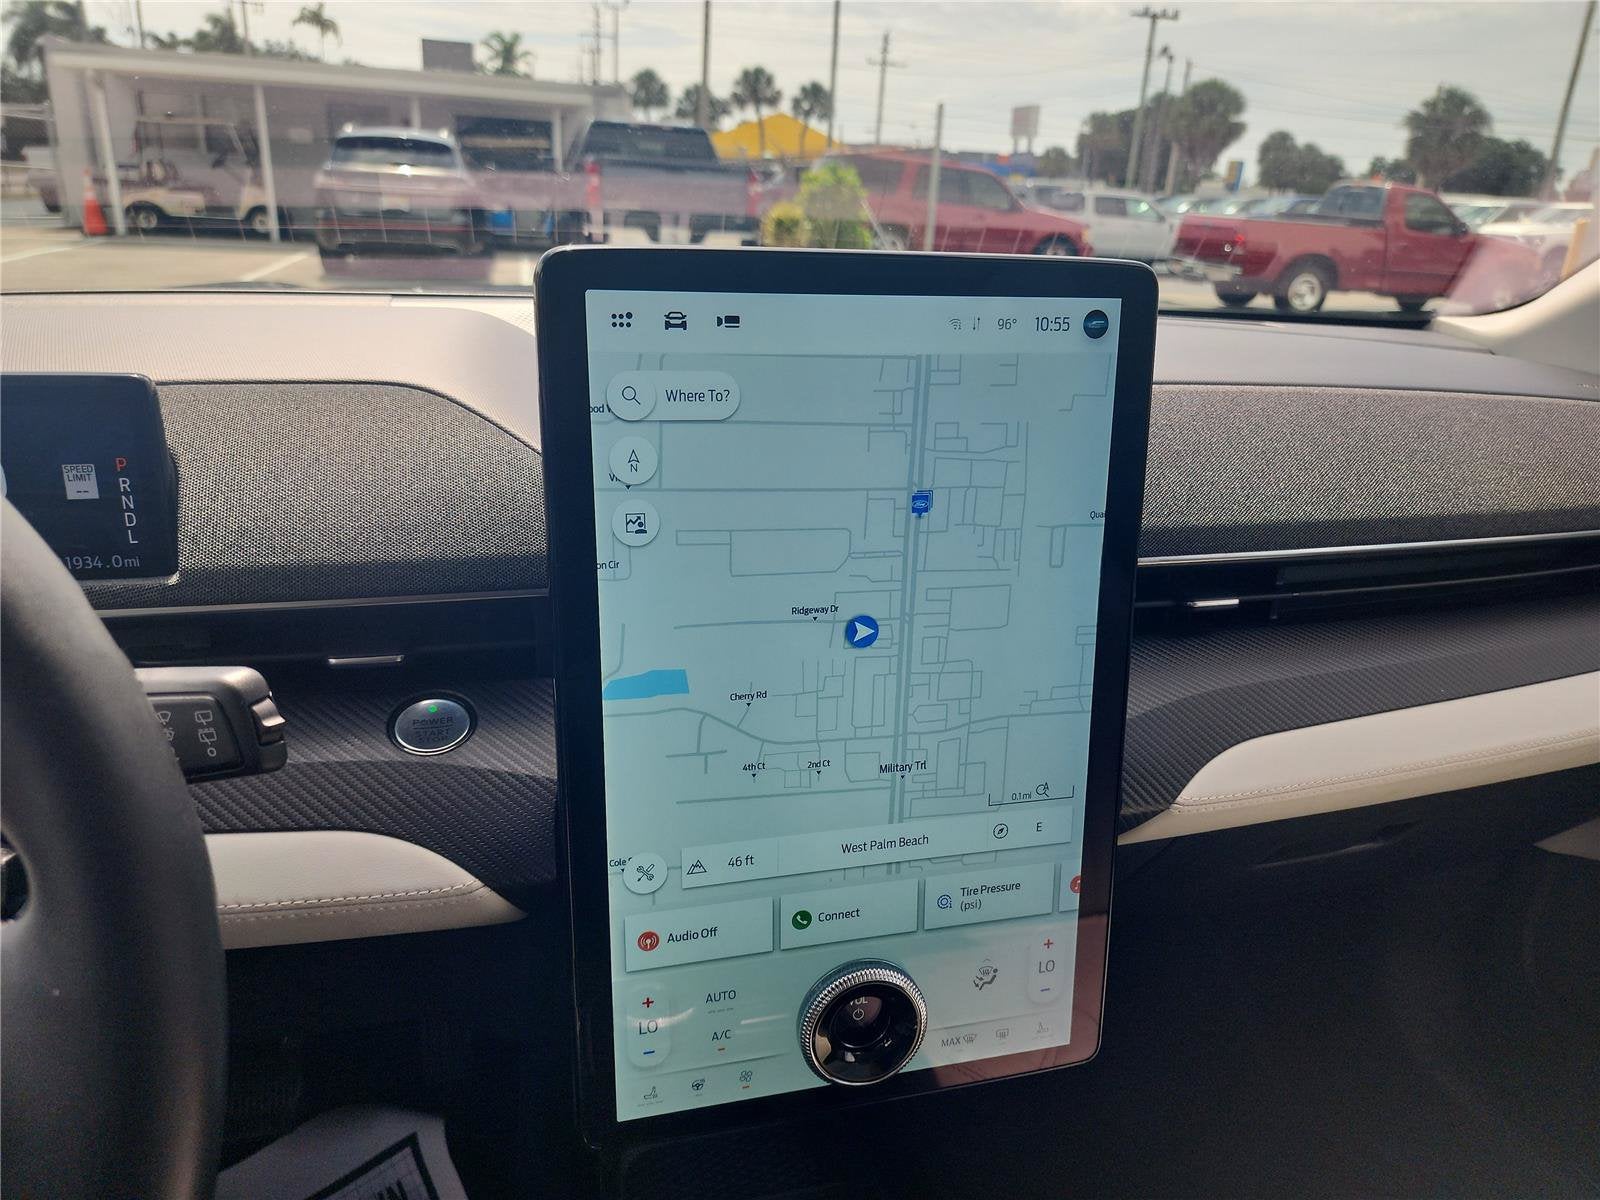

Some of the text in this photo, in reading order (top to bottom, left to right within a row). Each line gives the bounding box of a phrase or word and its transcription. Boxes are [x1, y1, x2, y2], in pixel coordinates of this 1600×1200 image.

[997, 318, 1017, 331] 96°
[1035, 316, 1070, 332] 10:55
[665, 388, 730, 402] Where To?
[63, 465, 93, 475] SPEED
[115, 457, 128, 471] P
[630, 463, 638, 473] N
[67, 473, 92, 482] LIMIT
[118, 477, 130, 492] R
[122, 495, 134, 510] N
[124, 512, 137, 527] D
[128, 529, 138, 544] L
[608, 560, 620, 569] Cir
[791, 604, 839, 616] Ridgeway Dr
[730, 690, 767, 702] Cherry Rd
[413, 716, 454, 726] POWER
[742, 762, 766, 772] 4th Ct
[807, 759, 831, 769] 2nd Ct
[879, 760, 927, 774] Military Trl
[1036, 821, 1043, 832] E
[841, 834, 929, 854] West Palm Beach
[609, 857, 627, 867] Cole
[727, 855, 755, 868] 46 ft
[960, 880, 1021, 897] Tire Pressure
[960, 898, 982, 912] (psi)
[818, 907, 861, 923] Connect
[667, 926, 718, 944] Audio Off
[1038, 959, 1055, 974] LO
[706, 989, 737, 1004] AUTO
[638, 1021, 658, 1035] LO
[711, 1029, 731, 1042] A/C
[941, 1036, 961, 1047] MAX
